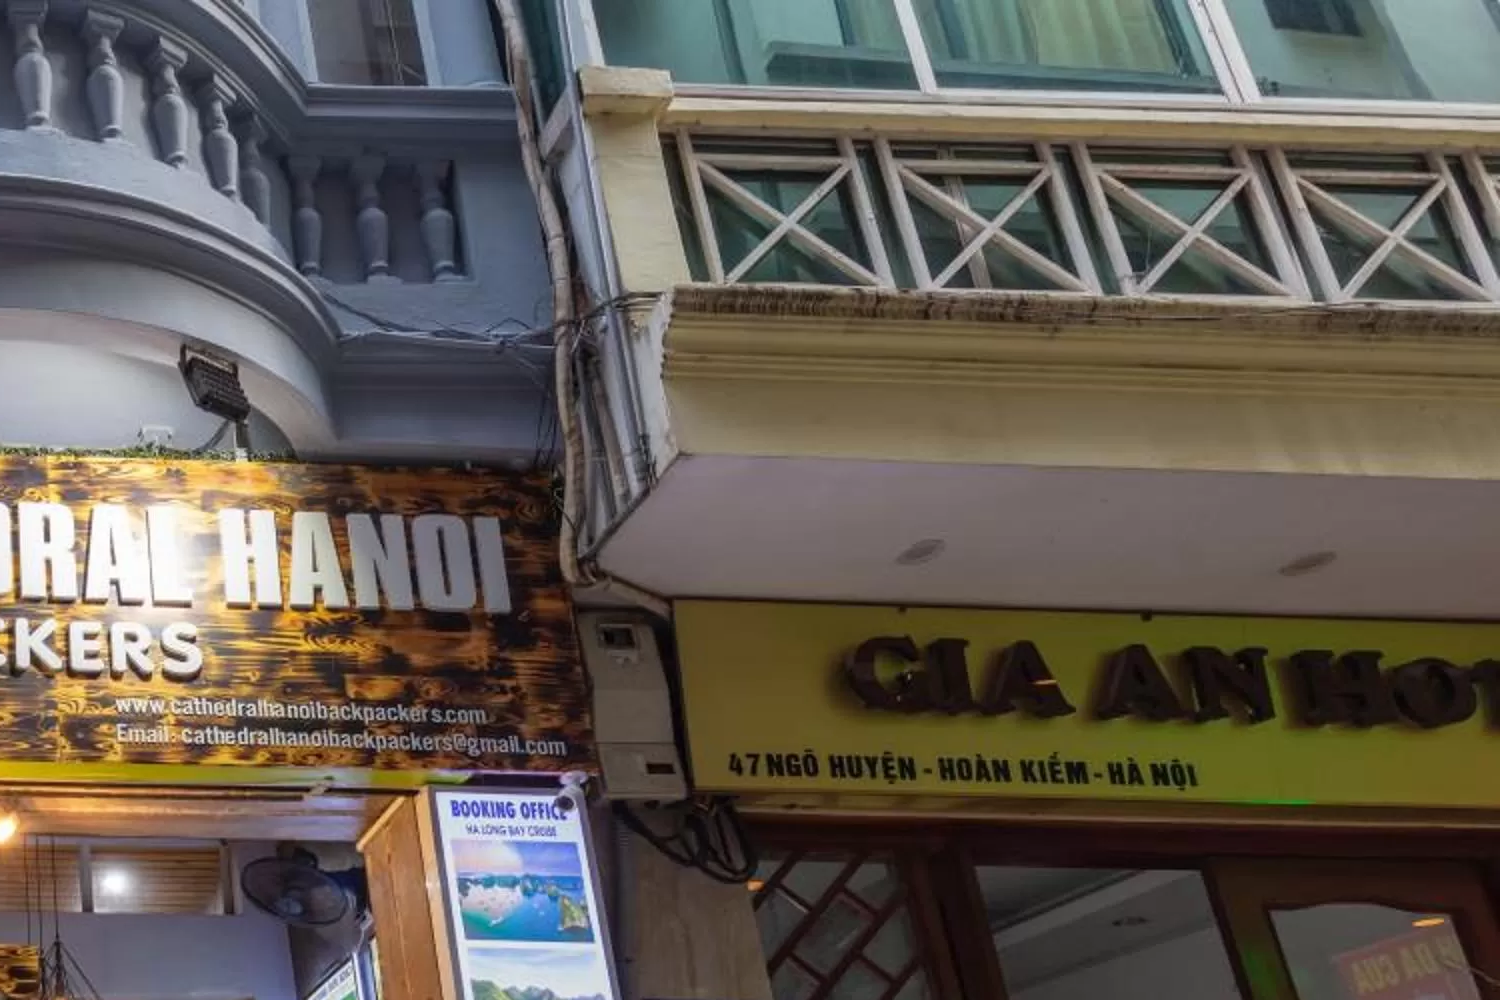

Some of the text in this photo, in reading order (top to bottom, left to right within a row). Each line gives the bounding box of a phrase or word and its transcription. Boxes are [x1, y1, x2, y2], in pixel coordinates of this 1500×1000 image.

[219, 507, 512, 613] HANOI
[842, 636, 1077, 718] GIA
[1098, 643, 1276, 725] AN
[182, 727, 568, 758] cathedralhanoibackpackers@gmail.com
[728, 752, 761, 777] 47
[938, 753, 1013, 784] HOÀN
[1108, 757, 1146, 787] HÀ
[451, 799, 515, 818] BOOKING
